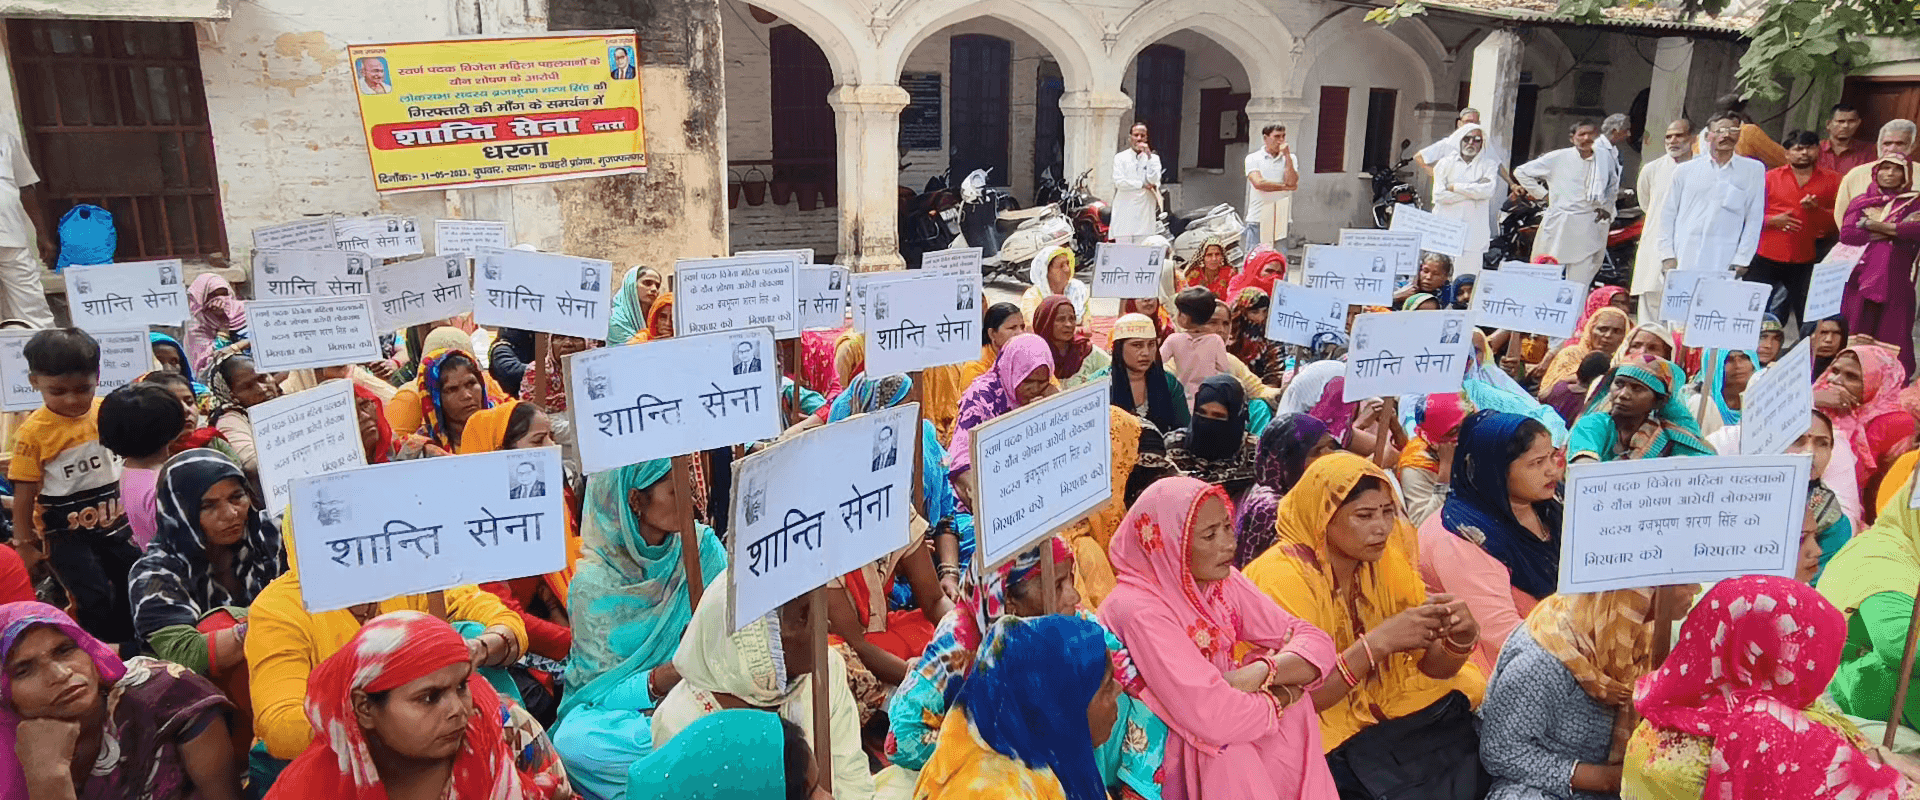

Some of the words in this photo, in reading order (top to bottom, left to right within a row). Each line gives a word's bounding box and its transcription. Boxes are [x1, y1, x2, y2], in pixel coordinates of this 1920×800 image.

[427, 65, 456, 73] पदक
[460, 62, 496, 72] विजेता
[500, 60, 535, 70] महिला
[589, 56, 601, 66] के
[510, 74, 522, 82] के
[525, 72, 559, 82] आरोपी
[400, 92, 450, 102] लोकसभा
[593, 81, 607, 90] की
[407, 102, 470, 118] गिरफ्तारी
[474, 101, 493, 113] की
[528, 98, 542, 109] के
[546, 95, 589, 108] समर्थन
[592, 94, 605, 106] में
[391, 121, 497, 146] शान्ति
[507, 116, 580, 137] सेना
[482, 141, 549, 159] धरना
[539, 158, 568, 169] कचहरी
[337, 236, 369, 250] शान्ति
[376, 233, 399, 248] सेना
[267, 275, 317, 295] शान्ति
[326, 276, 362, 295] सेना
[1101, 266, 1130, 285] शान्ति
[1135, 267, 1155, 284] सेना
[1306, 271, 1345, 290] शान्ति
[1354, 273, 1383, 292] सेना
[81, 292, 133, 316] शान्ति
[141, 288, 178, 309] सेना
[382, 290, 425, 315] शान्ति
[432, 283, 463, 303] सेना
[486, 285, 545, 313] शान्ति
[556, 290, 598, 319] सेना
[813, 292, 839, 314] सेना
[1277, 311, 1310, 332] शान्ति
[1482, 297, 1526, 317] शान्ति
[1534, 302, 1568, 324] सेना
[1694, 310, 1728, 332] शान्ति
[876, 318, 927, 351] शान्ति
[936, 314, 972, 343] सेना
[1356, 349, 1405, 378] शान्ति
[1414, 347, 1455, 373] सेना
[593, 393, 683, 437] शान्ति
[698, 382, 762, 418] सेना
[1582, 480, 1607, 494] स्वर्ण
[1613, 481, 1640, 491] पदक
[1647, 475, 1681, 489] विजेता
[1688, 473, 1723, 486] महिला
[1592, 500, 1604, 512] के
[1610, 498, 1632, 510] यौन
[1638, 496, 1671, 508] शोषण
[1677, 490, 1714, 505] आरोपी
[1721, 490, 1772, 503] लोकसभा
[746, 508, 825, 577] शान्ति
[839, 483, 893, 533] सेना
[1599, 525, 1632, 536] सदस्य
[1686, 516, 1712, 528] शरण
[1718, 511, 1738, 527] सिंह
[1744, 514, 1760, 526] को
[325, 519, 443, 568] शान्ति
[464, 506, 545, 548] सेना
[1639, 544, 1662, 560] करो
[1753, 539, 1779, 554] करो
